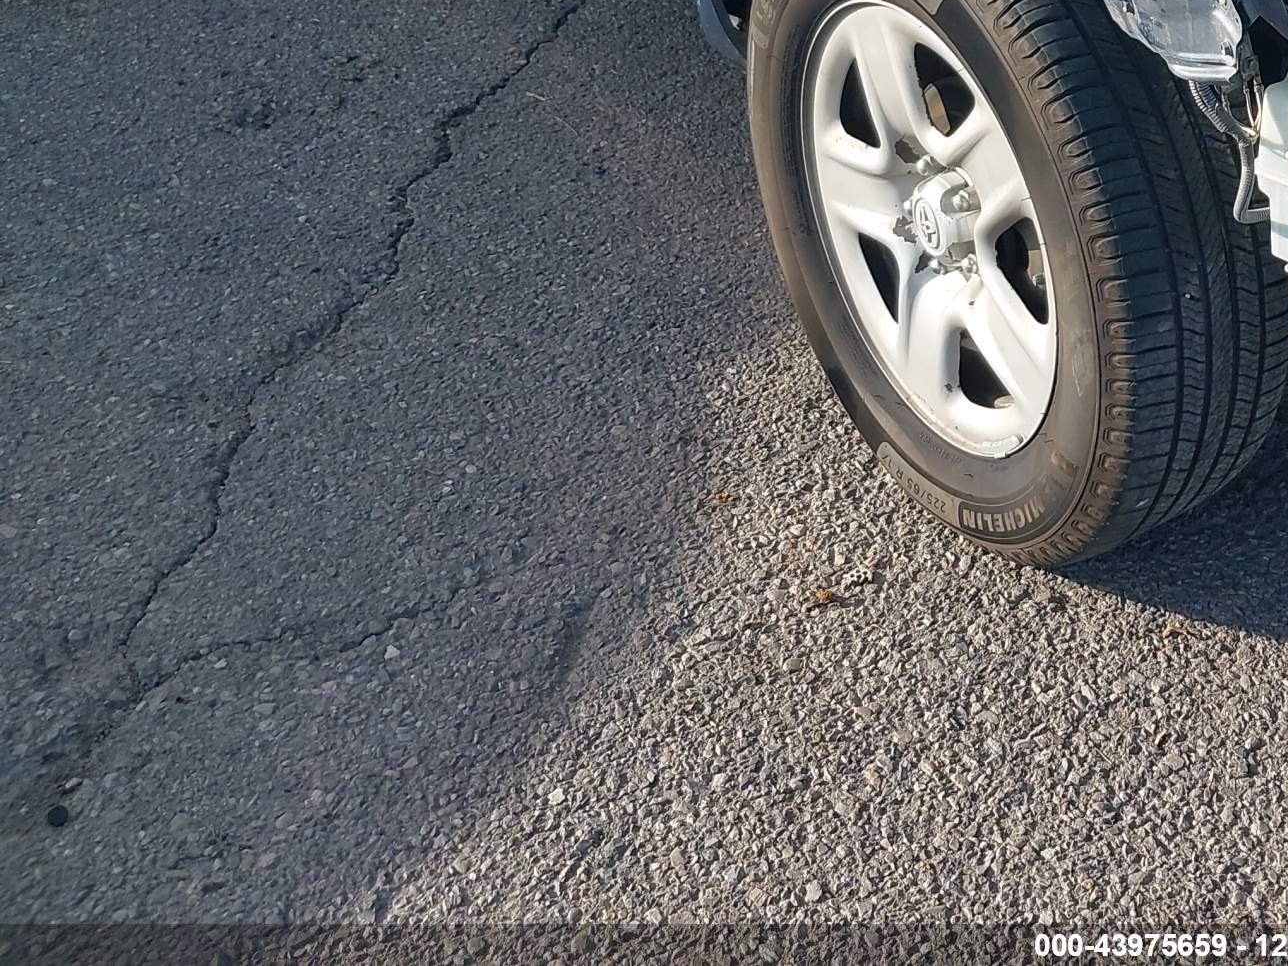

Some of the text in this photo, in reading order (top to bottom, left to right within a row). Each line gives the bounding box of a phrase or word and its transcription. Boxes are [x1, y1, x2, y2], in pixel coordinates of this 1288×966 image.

[896, 467, 904, 480] R
[906, 478, 946, 513] 225/65
[962, 496, 1045, 532] MICHELIN
